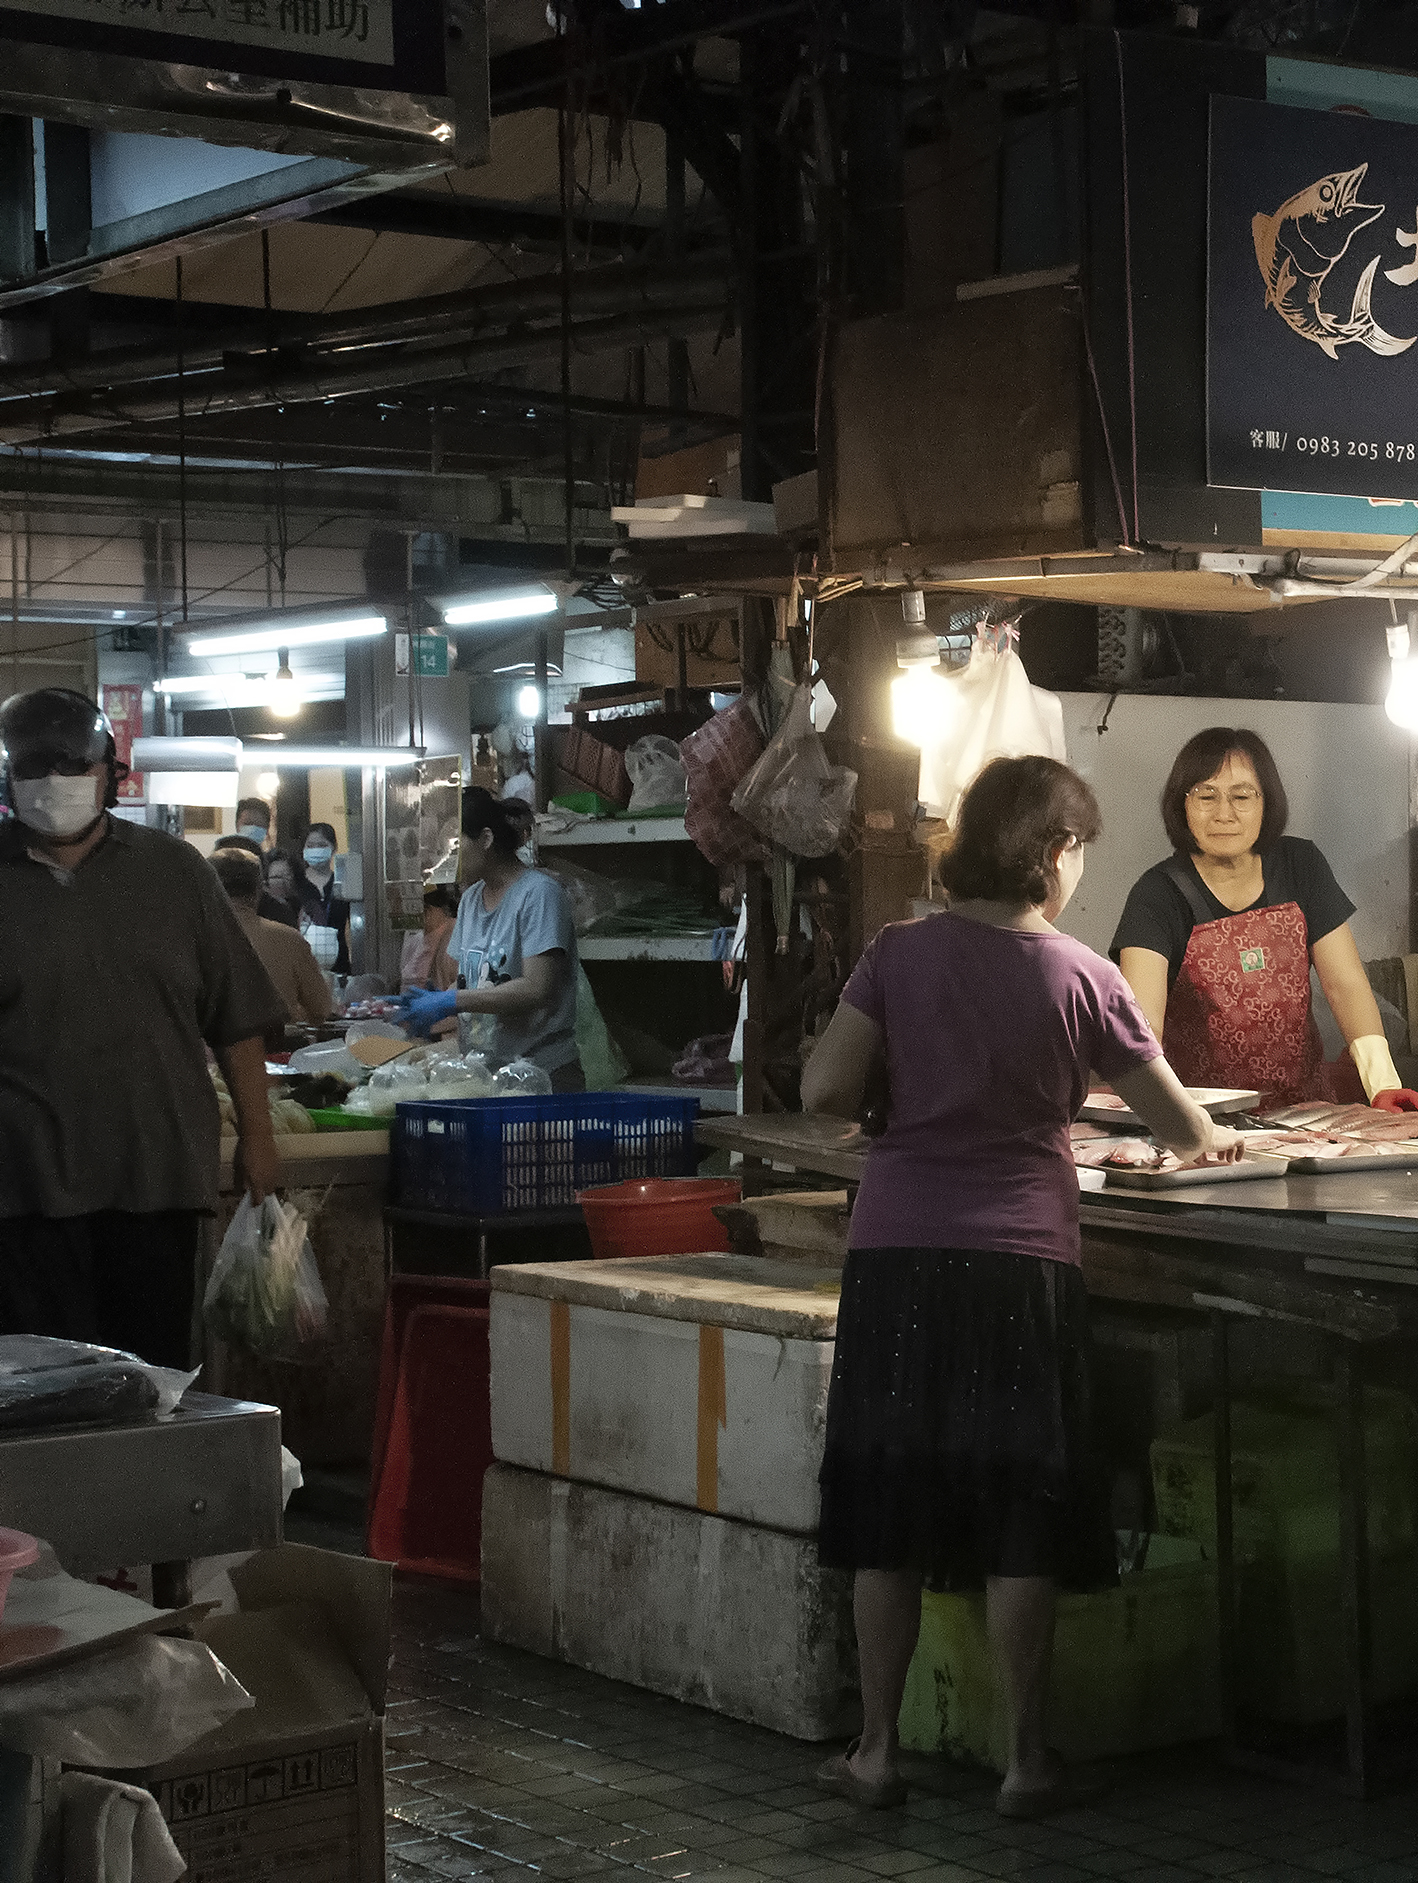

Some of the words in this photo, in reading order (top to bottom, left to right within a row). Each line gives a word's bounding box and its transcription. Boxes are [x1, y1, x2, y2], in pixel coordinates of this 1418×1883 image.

[1249, 429, 1288, 452] 客服/
[1296, 436, 1340, 457] 0983
[1347, 441, 1378, 461] 205
[1385, 441, 1416, 463] 878
[420, 655, 437, 668] 14
